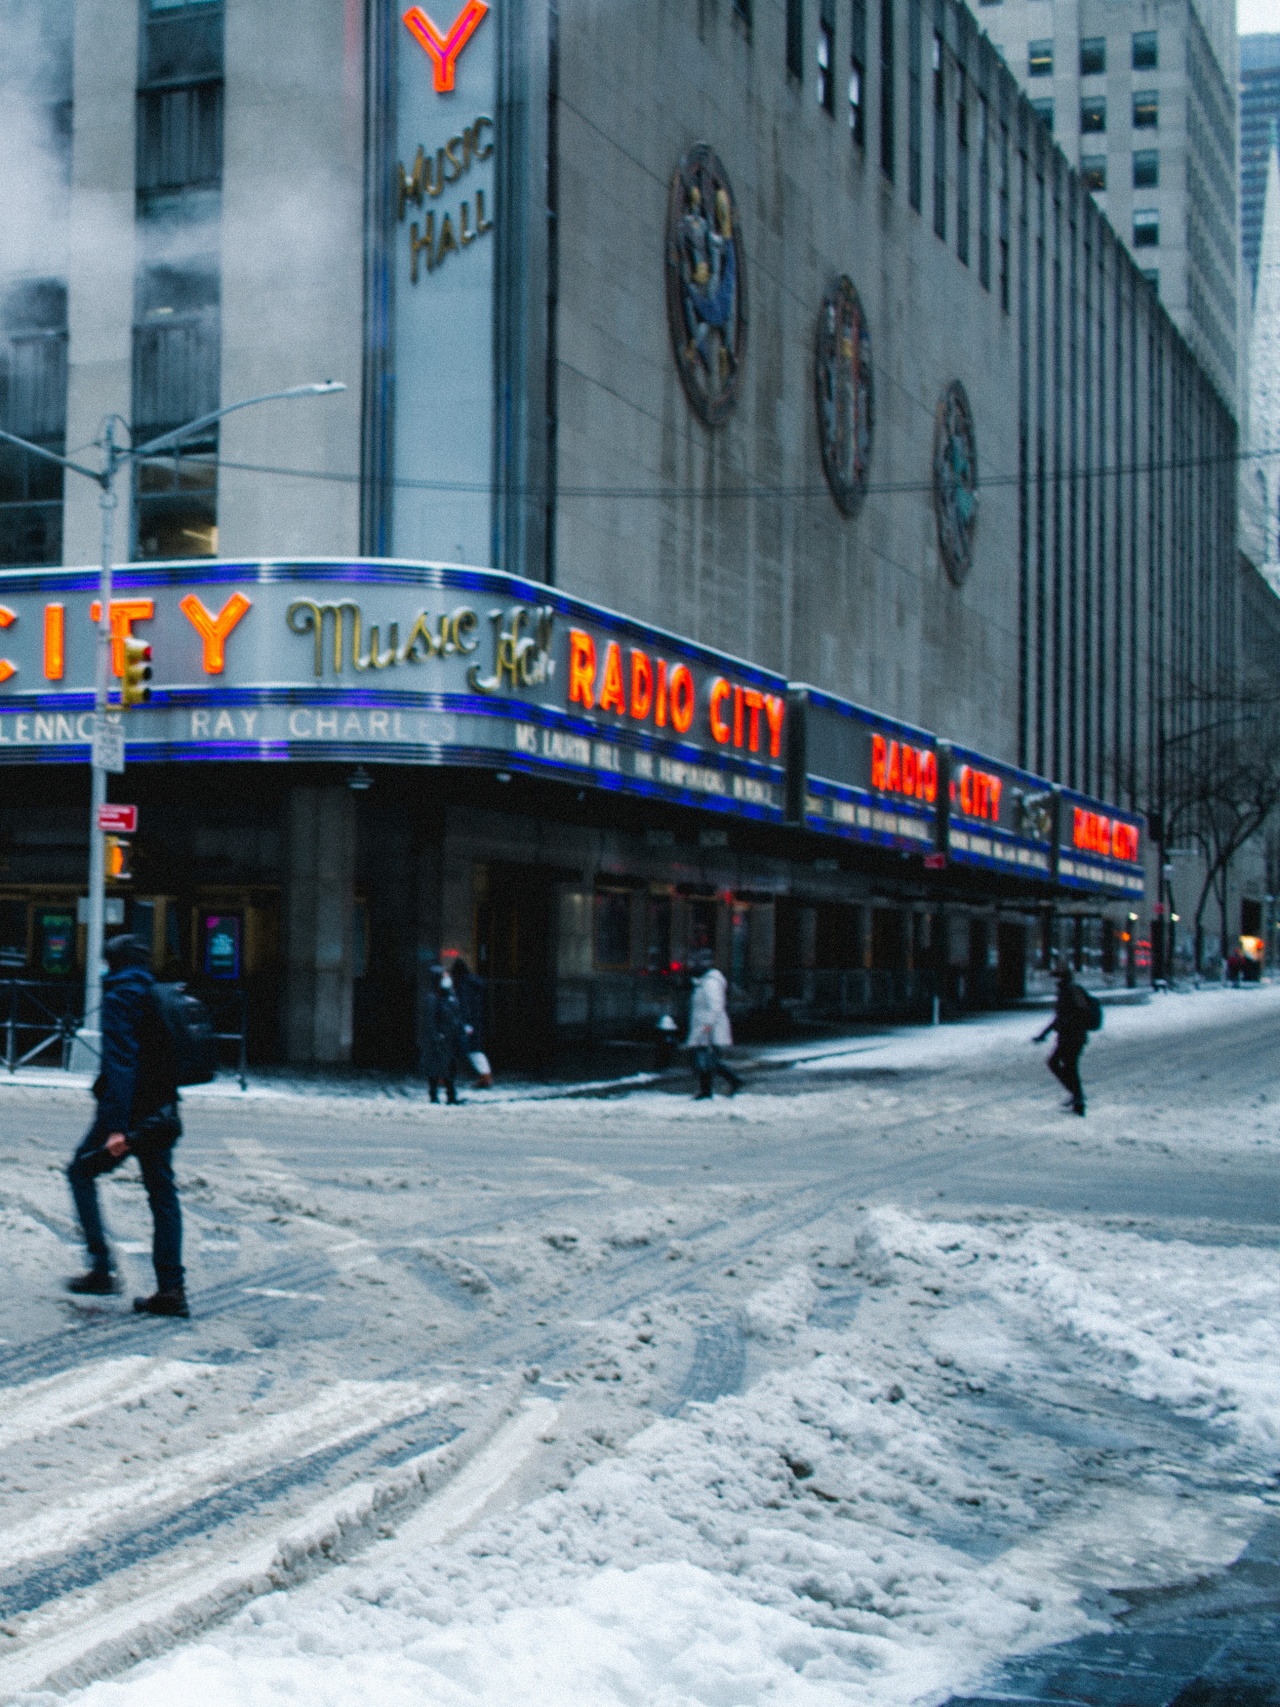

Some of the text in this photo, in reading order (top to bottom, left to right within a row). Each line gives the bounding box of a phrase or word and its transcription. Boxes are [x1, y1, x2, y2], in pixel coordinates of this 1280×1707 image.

[397, 116, 494, 222] MUSIC
[410, 189, 494, 286] HALL
[286, 597, 478, 678] Music
[191, 709, 259, 738] RAY
[288, 708, 456, 743] CHARL
[568, 627, 695, 734] RADIO
[709, 676, 785, 758] CITY
